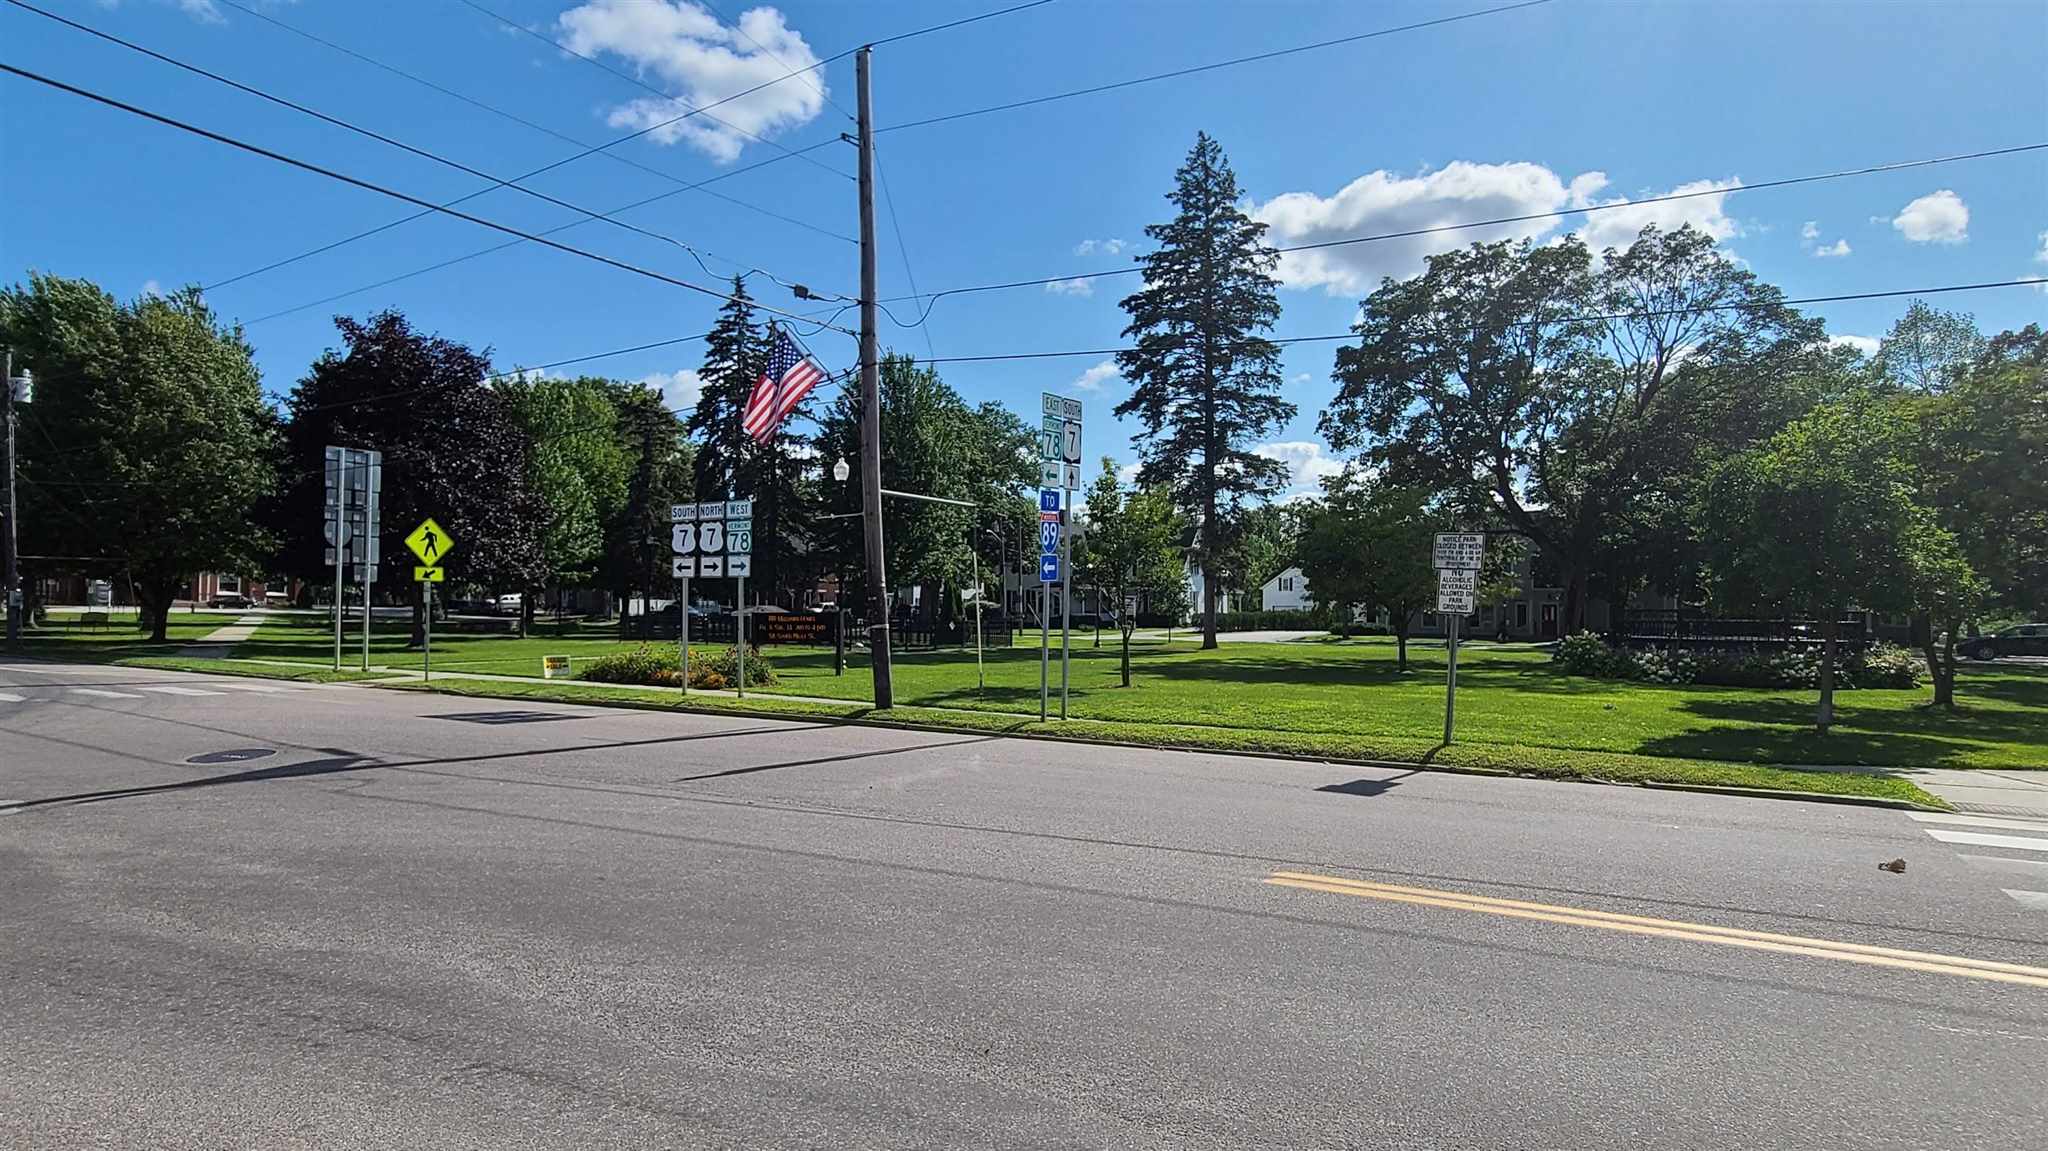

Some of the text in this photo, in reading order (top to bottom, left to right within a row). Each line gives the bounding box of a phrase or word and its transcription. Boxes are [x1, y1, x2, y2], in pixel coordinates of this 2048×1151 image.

[1046, 397, 1060, 411] EAST
[1064, 401, 1081, 416] SOUTH
[1045, 433, 1060, 457] 78
[1069, 431, 1076, 452] 7
[1045, 494, 1055, 507] TO
[672, 507, 697, 518] SOUTH
[700, 504, 723, 517] NORTH
[729, 503, 749, 515] WEST
[728, 522, 750, 530] VERMONT
[1043, 522, 1057, 545] 89
[680, 529, 689, 547] 7
[707, 528, 716, 546] 7
[730, 532, 749, 551] 78
